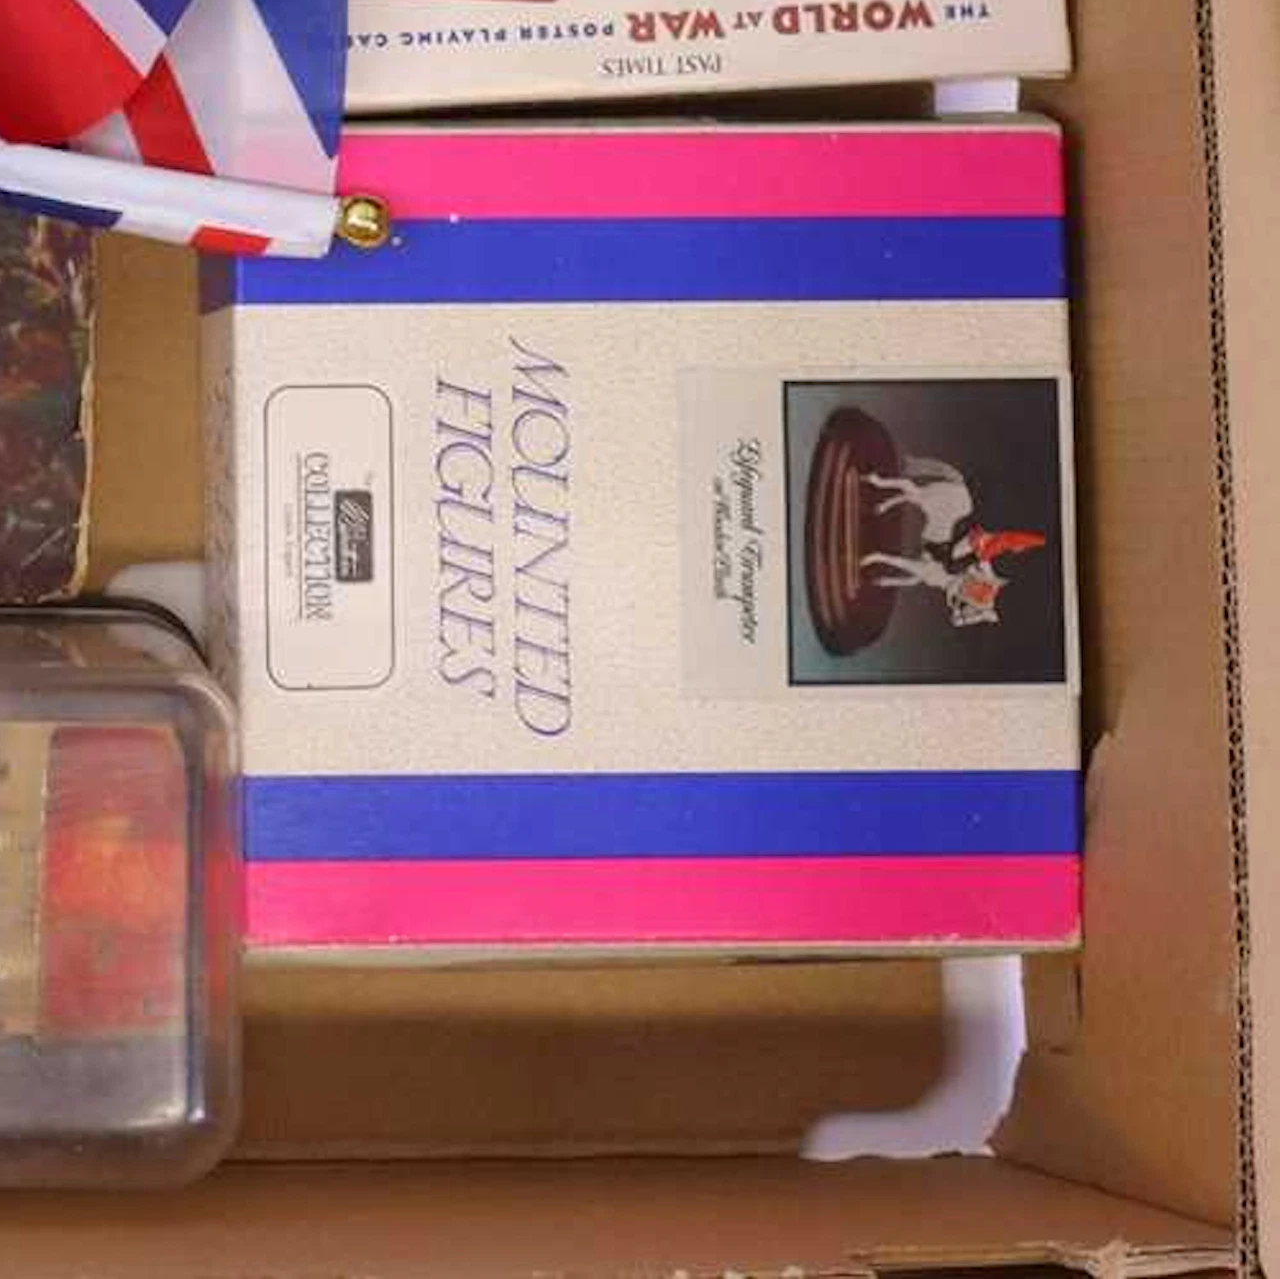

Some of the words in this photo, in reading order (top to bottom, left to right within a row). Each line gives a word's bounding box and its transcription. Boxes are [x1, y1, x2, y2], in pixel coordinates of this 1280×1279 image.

[732, 10, 766, 30] AT
[772, 0, 935, 36] WORLD
[944, 3, 990, 21] THE
[519, 22, 614, 43] POSTER
[626, 6, 726, 44] WAR
[400, 27, 507, 47] PLAYING
[600, 55, 670, 78] TIMES
[676, 53, 723, 75] PAST
[304, 451, 335, 622] COLLECTION
[435, 377, 497, 700] FIGURES
[509, 337, 573, 738] MOUNTED
